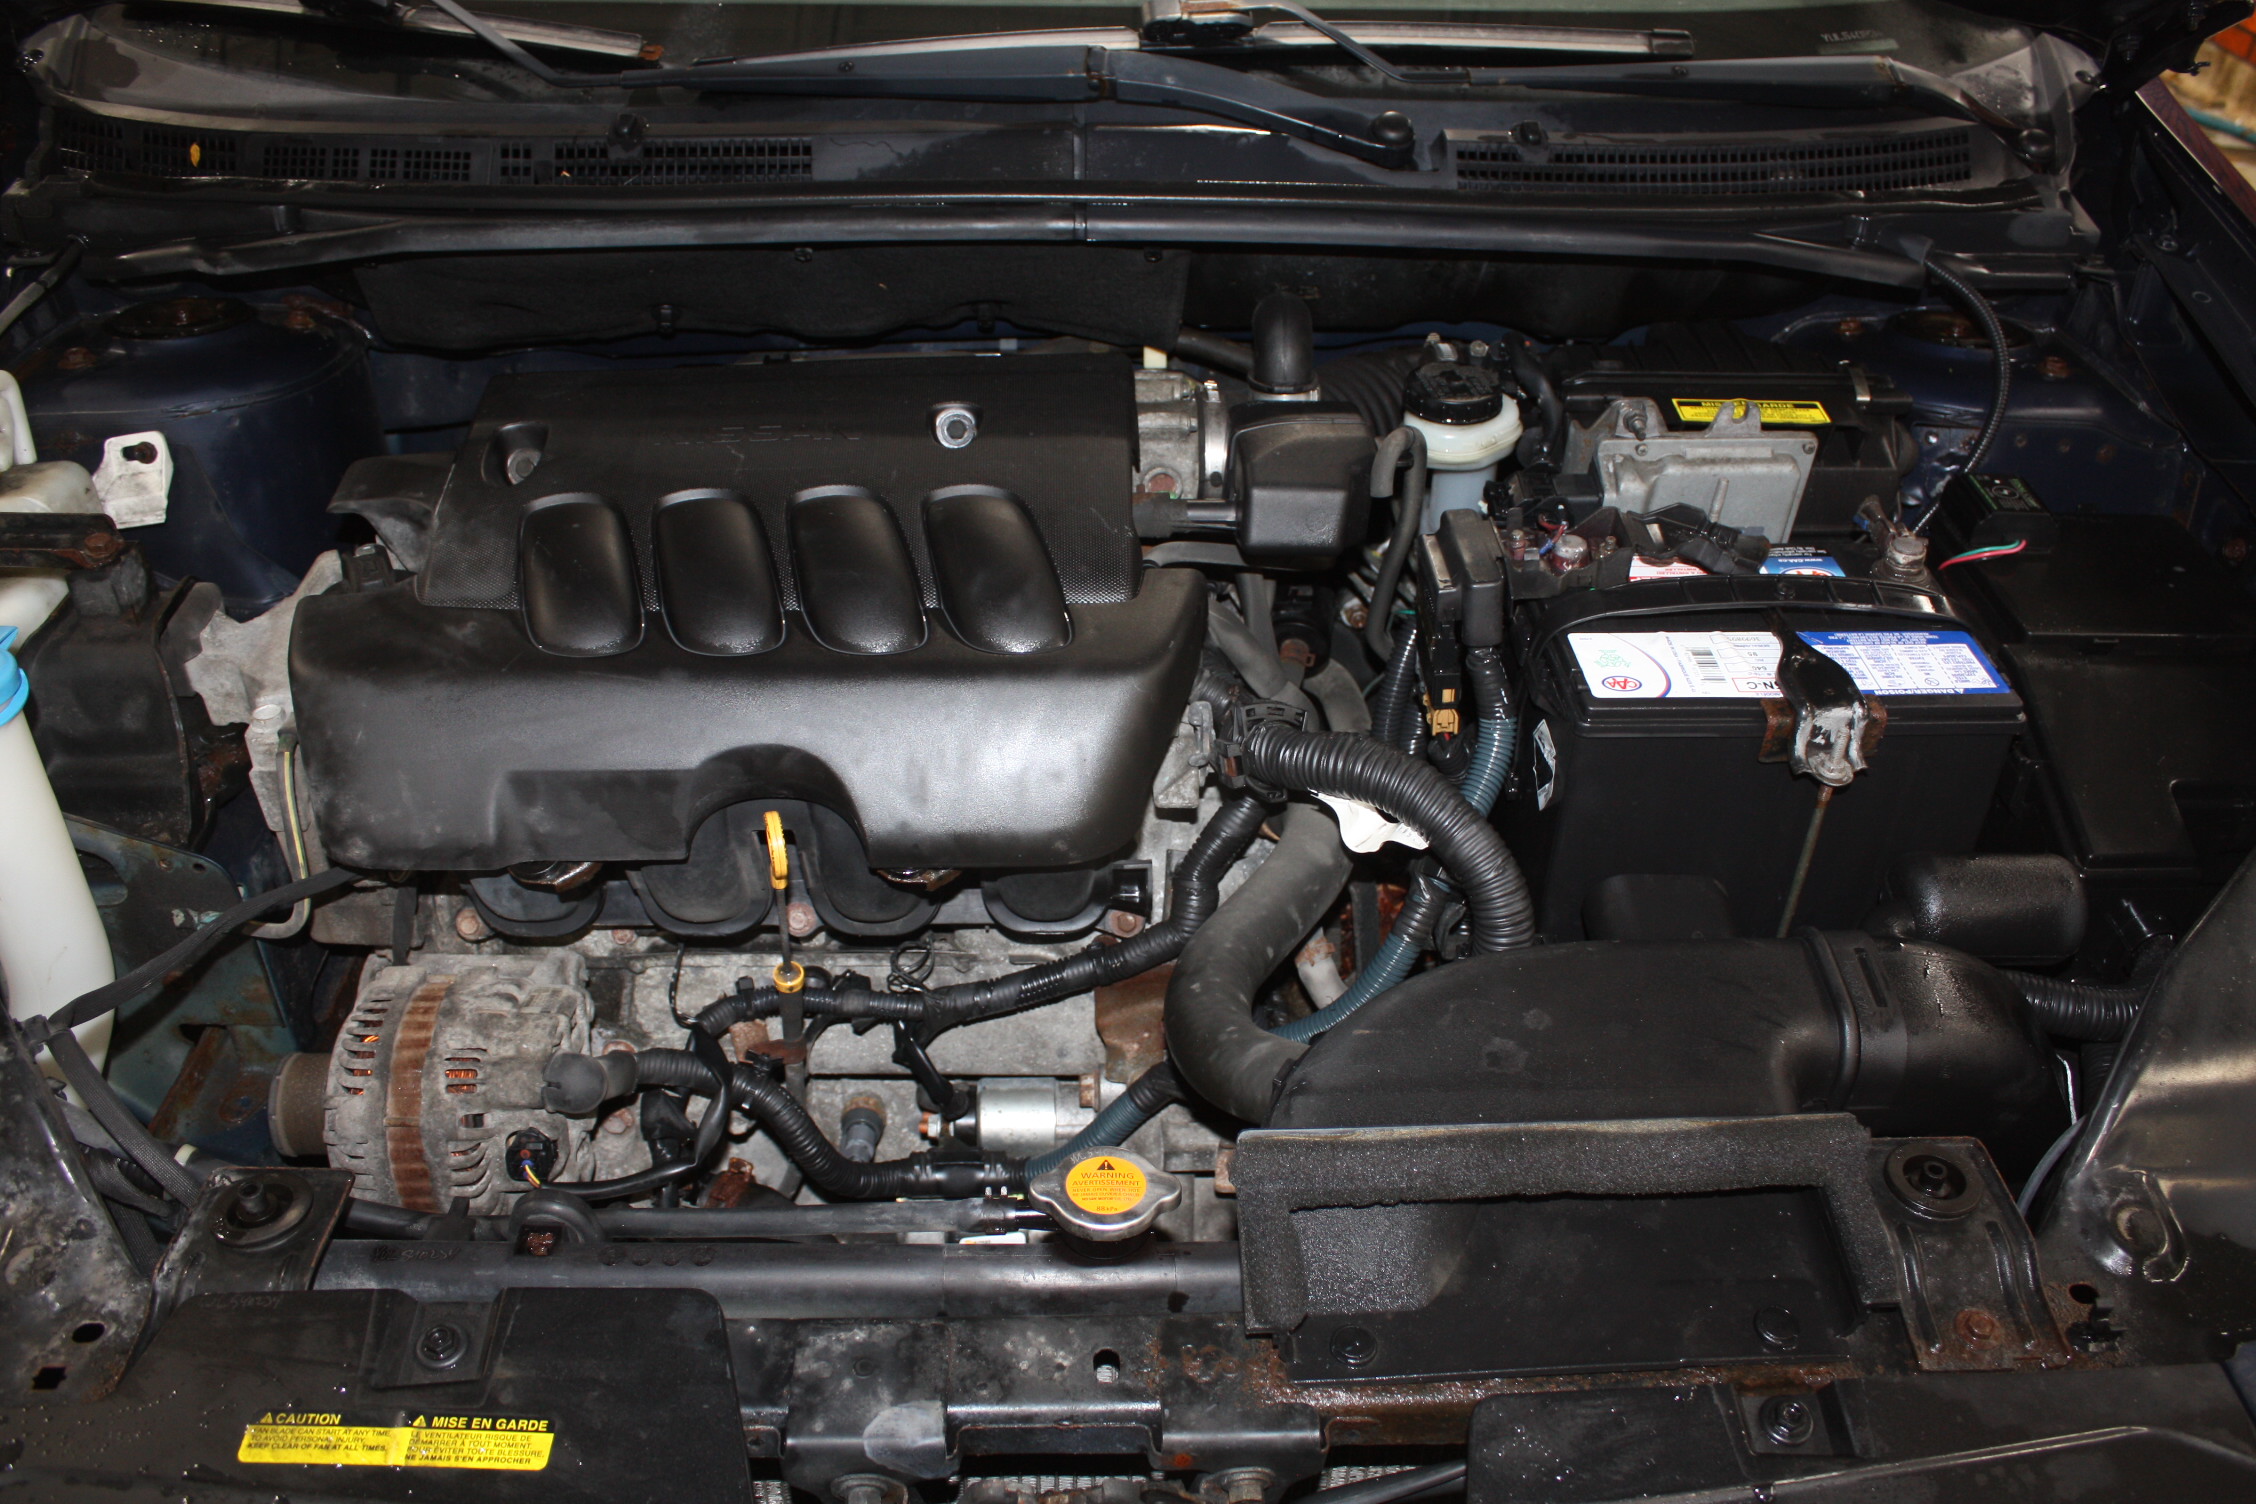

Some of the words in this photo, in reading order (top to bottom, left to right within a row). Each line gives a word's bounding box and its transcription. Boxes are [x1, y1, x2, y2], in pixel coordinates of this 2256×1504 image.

[1606, 677, 1639, 690] CAA
[276, 1413, 341, 1425] CAUTION
[432, 1416, 468, 1428] MISE
[471, 1418, 492, 1429] EN
[496, 1419, 548, 1431] GARDE
[424, 1432, 482, 1440] VENTILATEUR
[434, 1446, 464, 1454] ÉVITER
